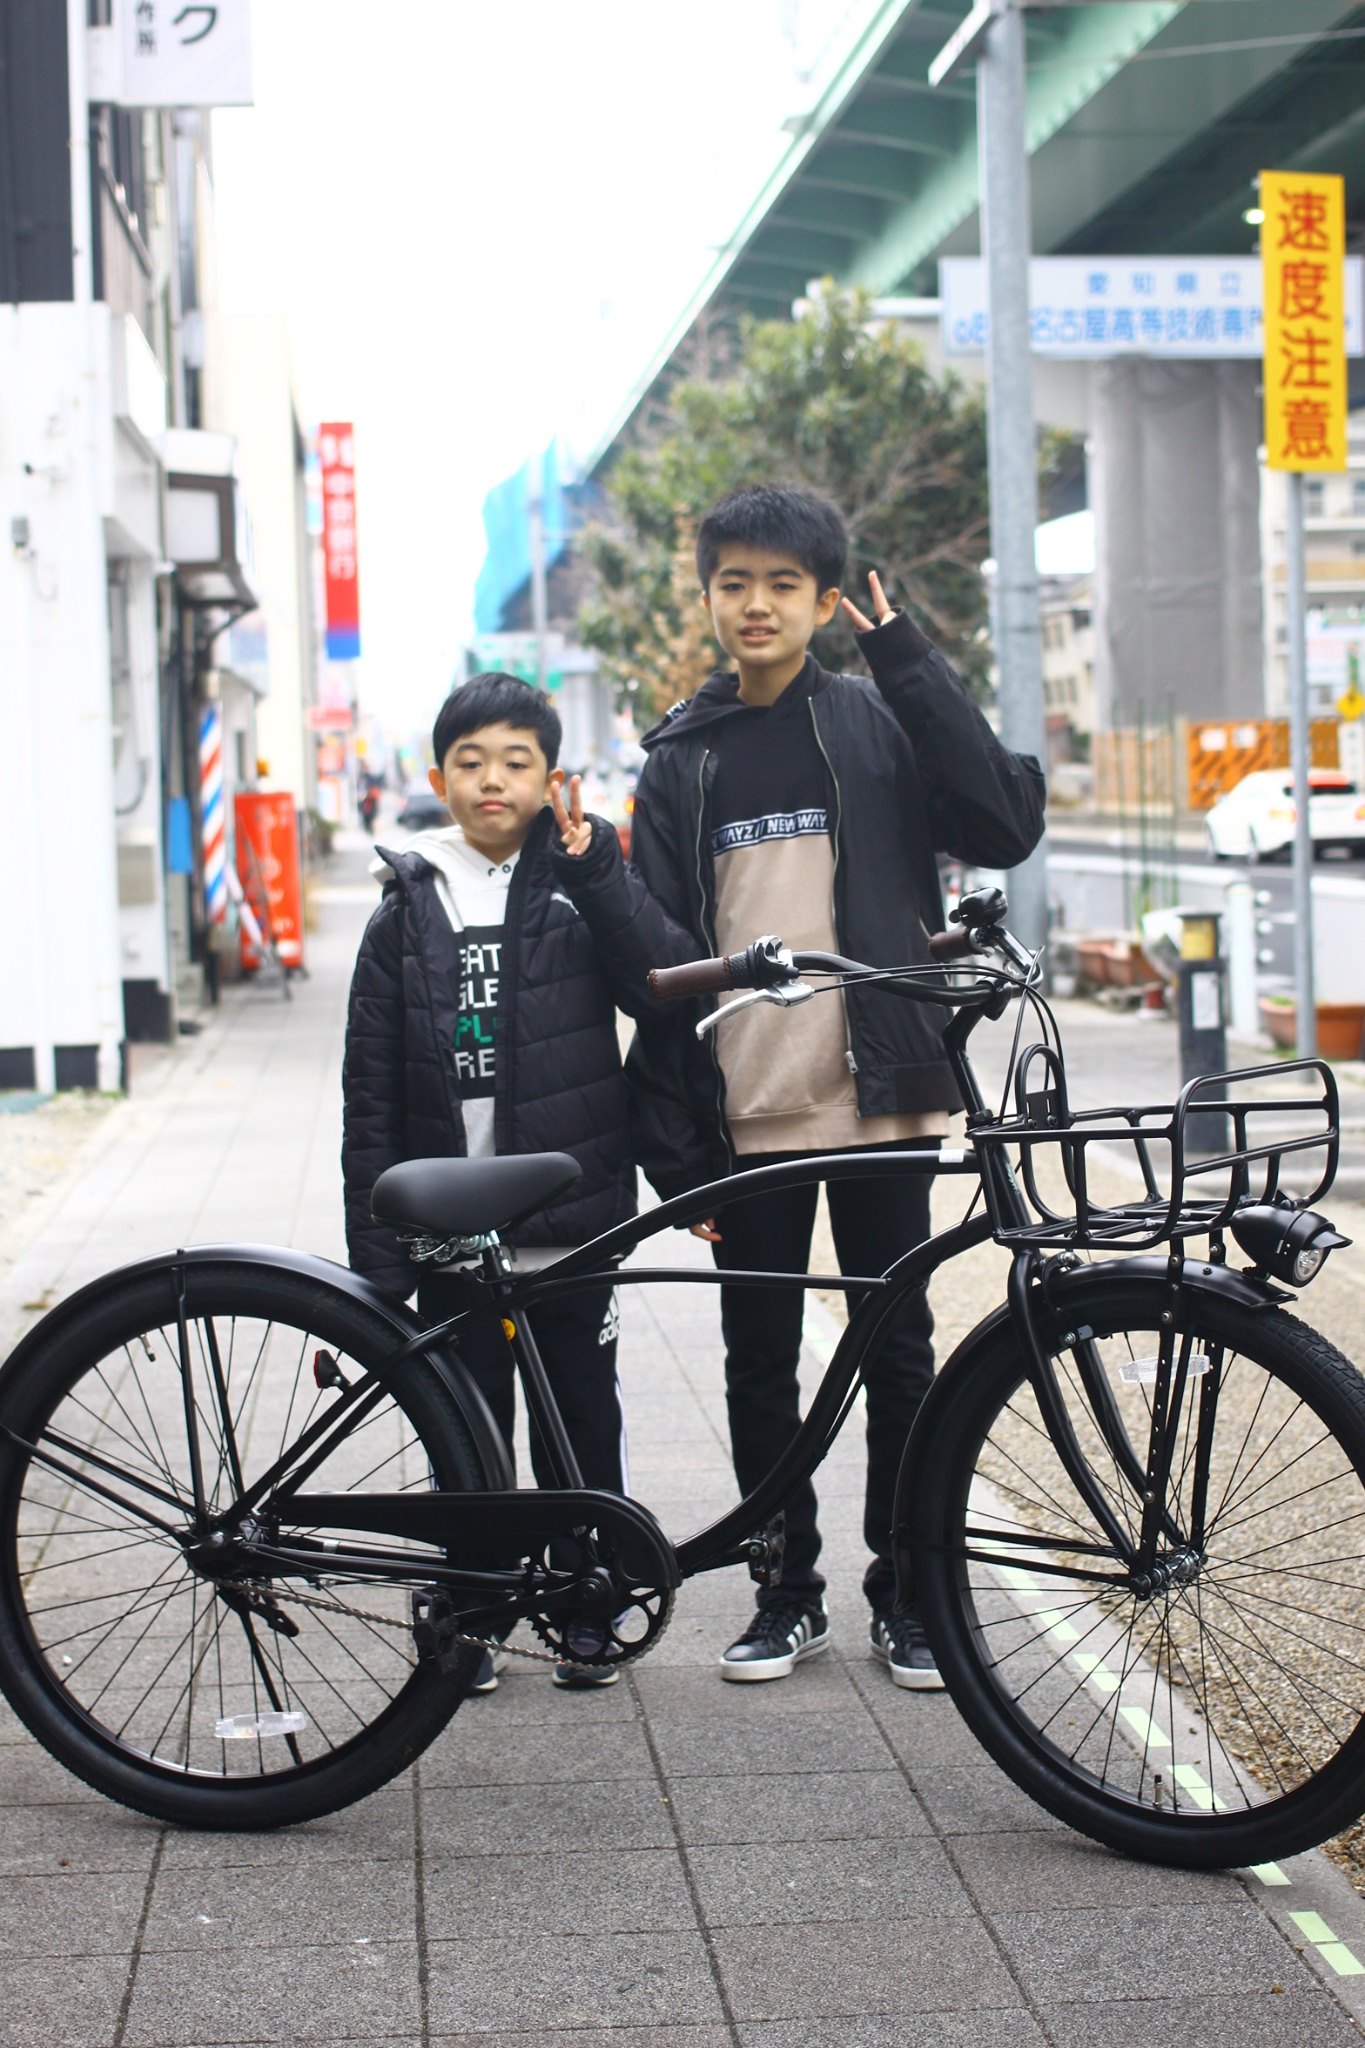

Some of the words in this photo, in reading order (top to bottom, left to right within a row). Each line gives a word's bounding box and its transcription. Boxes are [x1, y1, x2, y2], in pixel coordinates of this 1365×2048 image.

[173, 5, 217, 45] ク
[1277, 188, 1333, 460] 速度注意
[767, 816, 796, 834] NEW
[455, 1014, 497, 1048] PL
